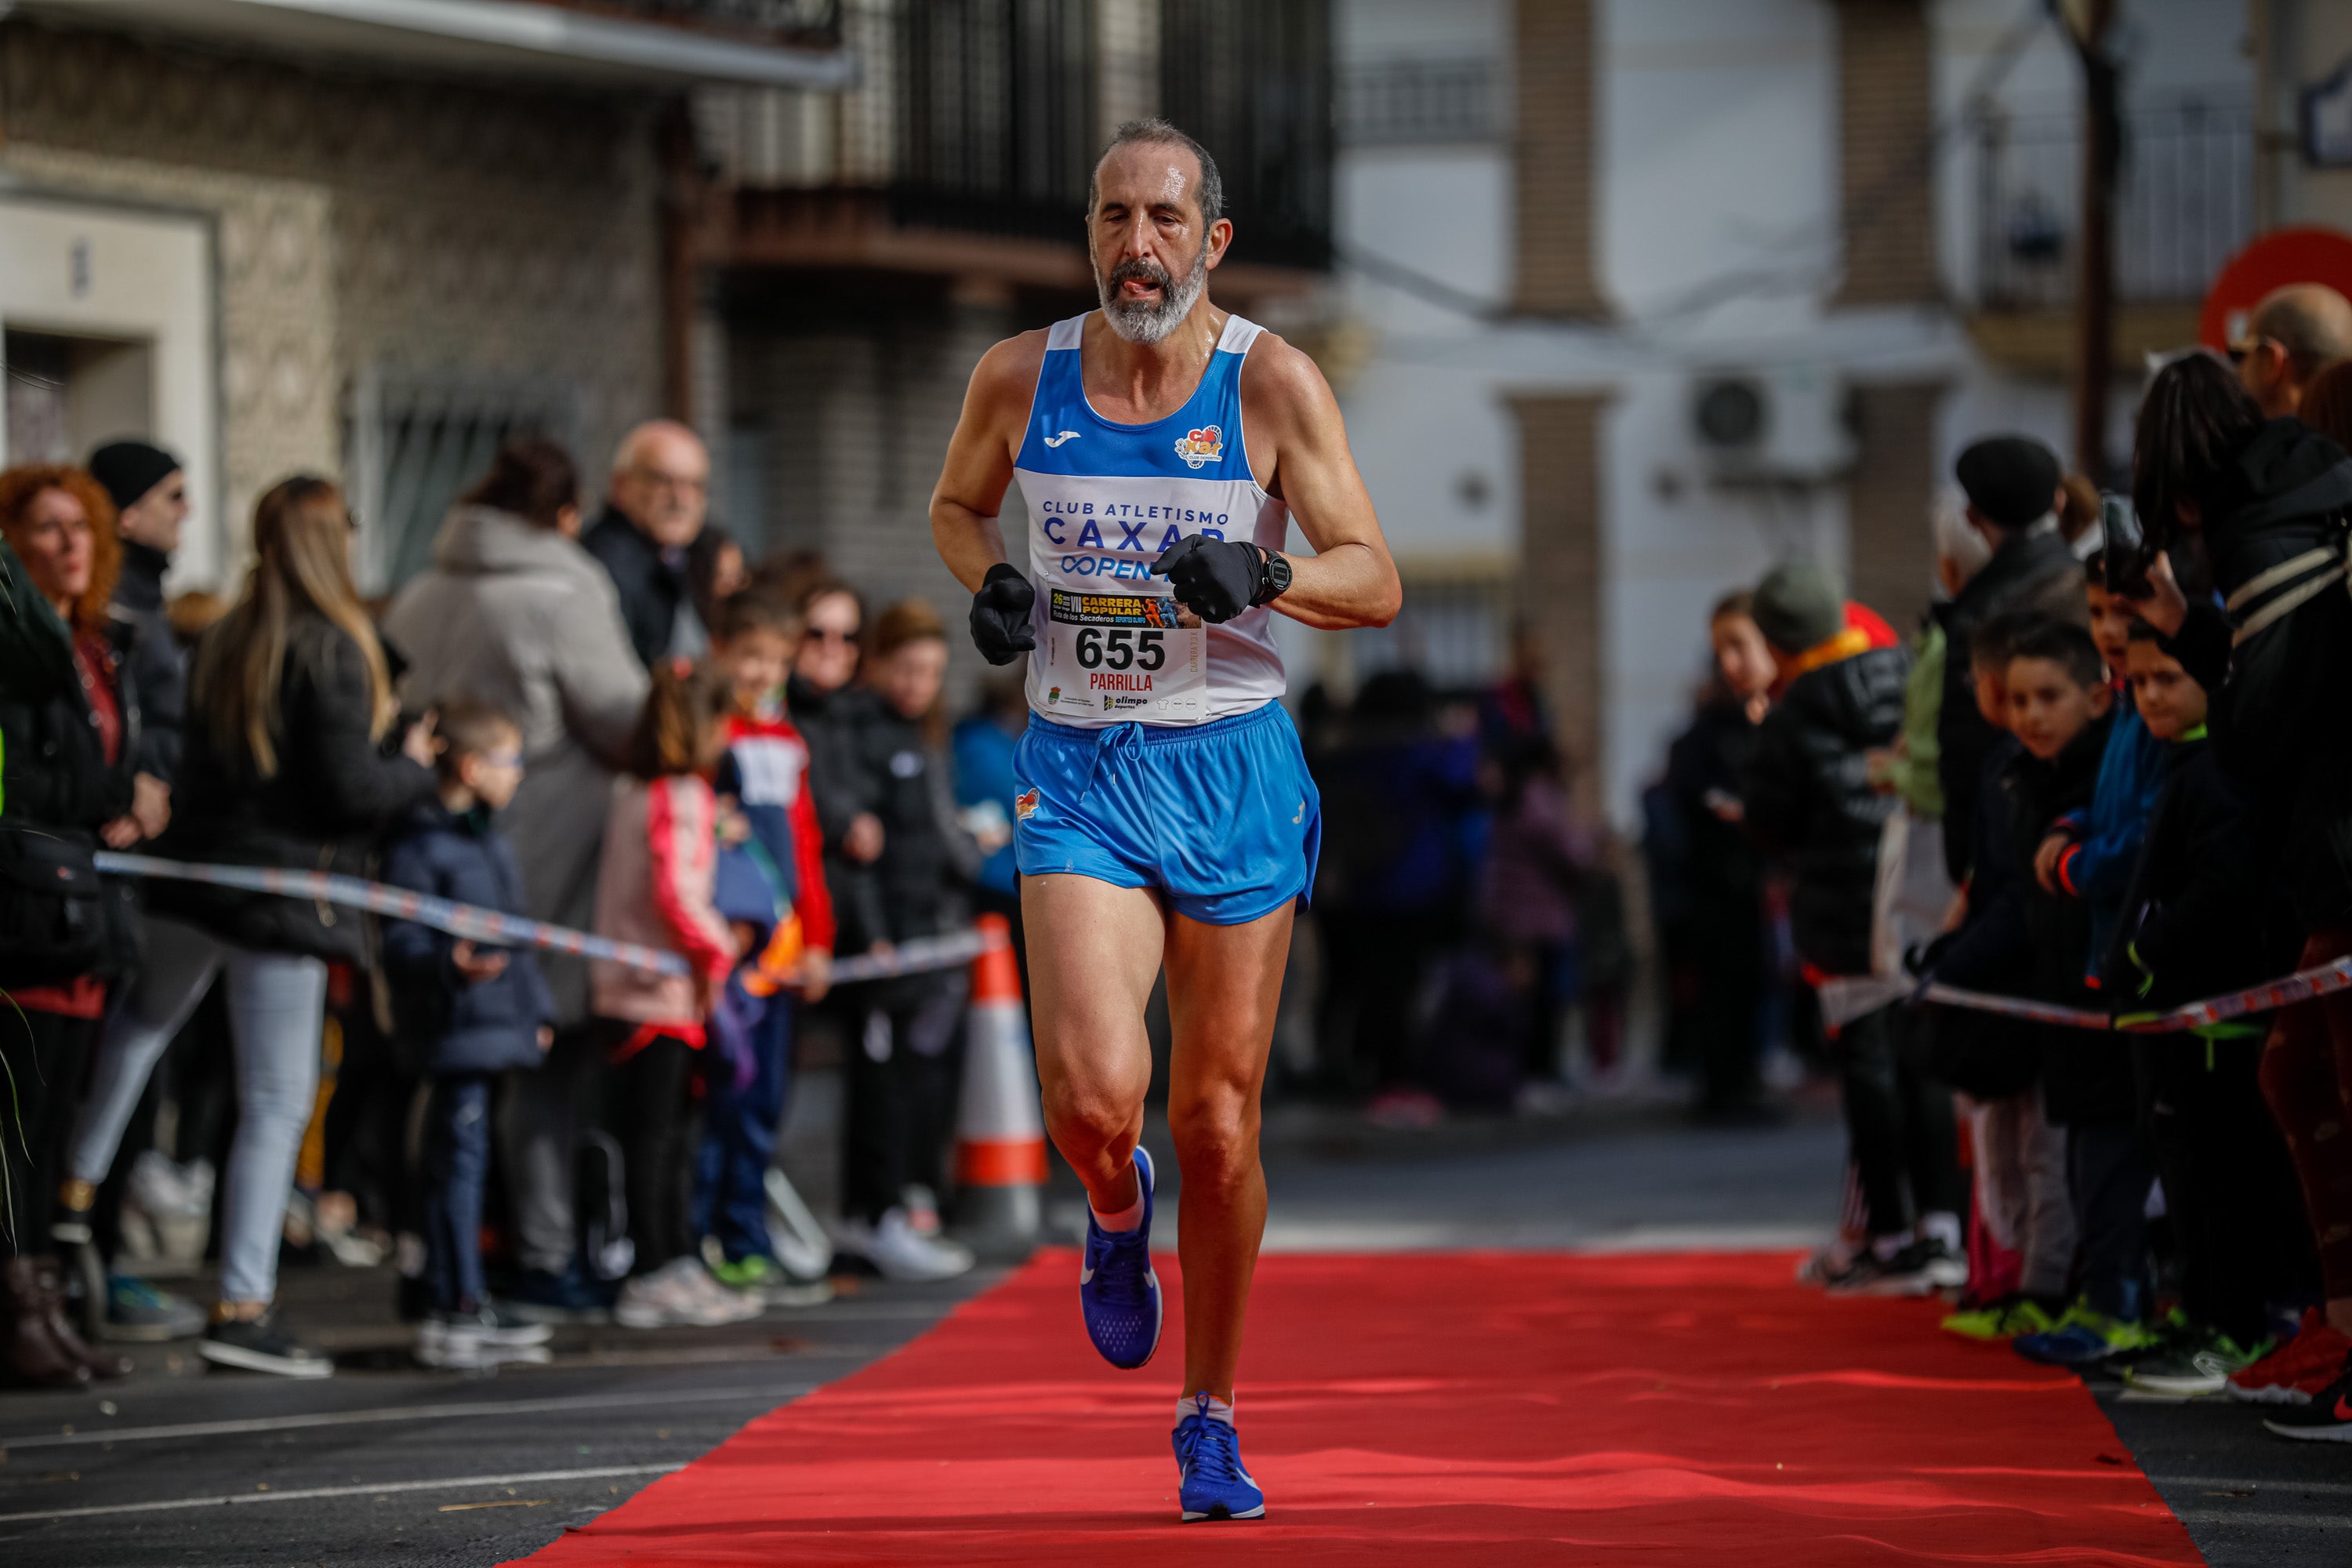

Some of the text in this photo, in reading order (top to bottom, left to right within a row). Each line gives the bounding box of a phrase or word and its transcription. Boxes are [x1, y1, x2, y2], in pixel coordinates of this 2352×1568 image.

[1043, 501, 1229, 525] CLUB ATLETISMO
[1053, 593, 1063, 605] 26
[1070, 596, 1082, 613] VII
[1082, 597, 1142, 608] CARRERA
[1083, 606, 1142, 615] POPULAR
[1080, 614, 1114, 622] Secaderos
[1076, 627, 1165, 671] 655
[1190, 647, 1199, 673] CARRERA
[1090, 673, 1152, 691] PARRILLA
[1116, 696, 1148, 706] olimpo
